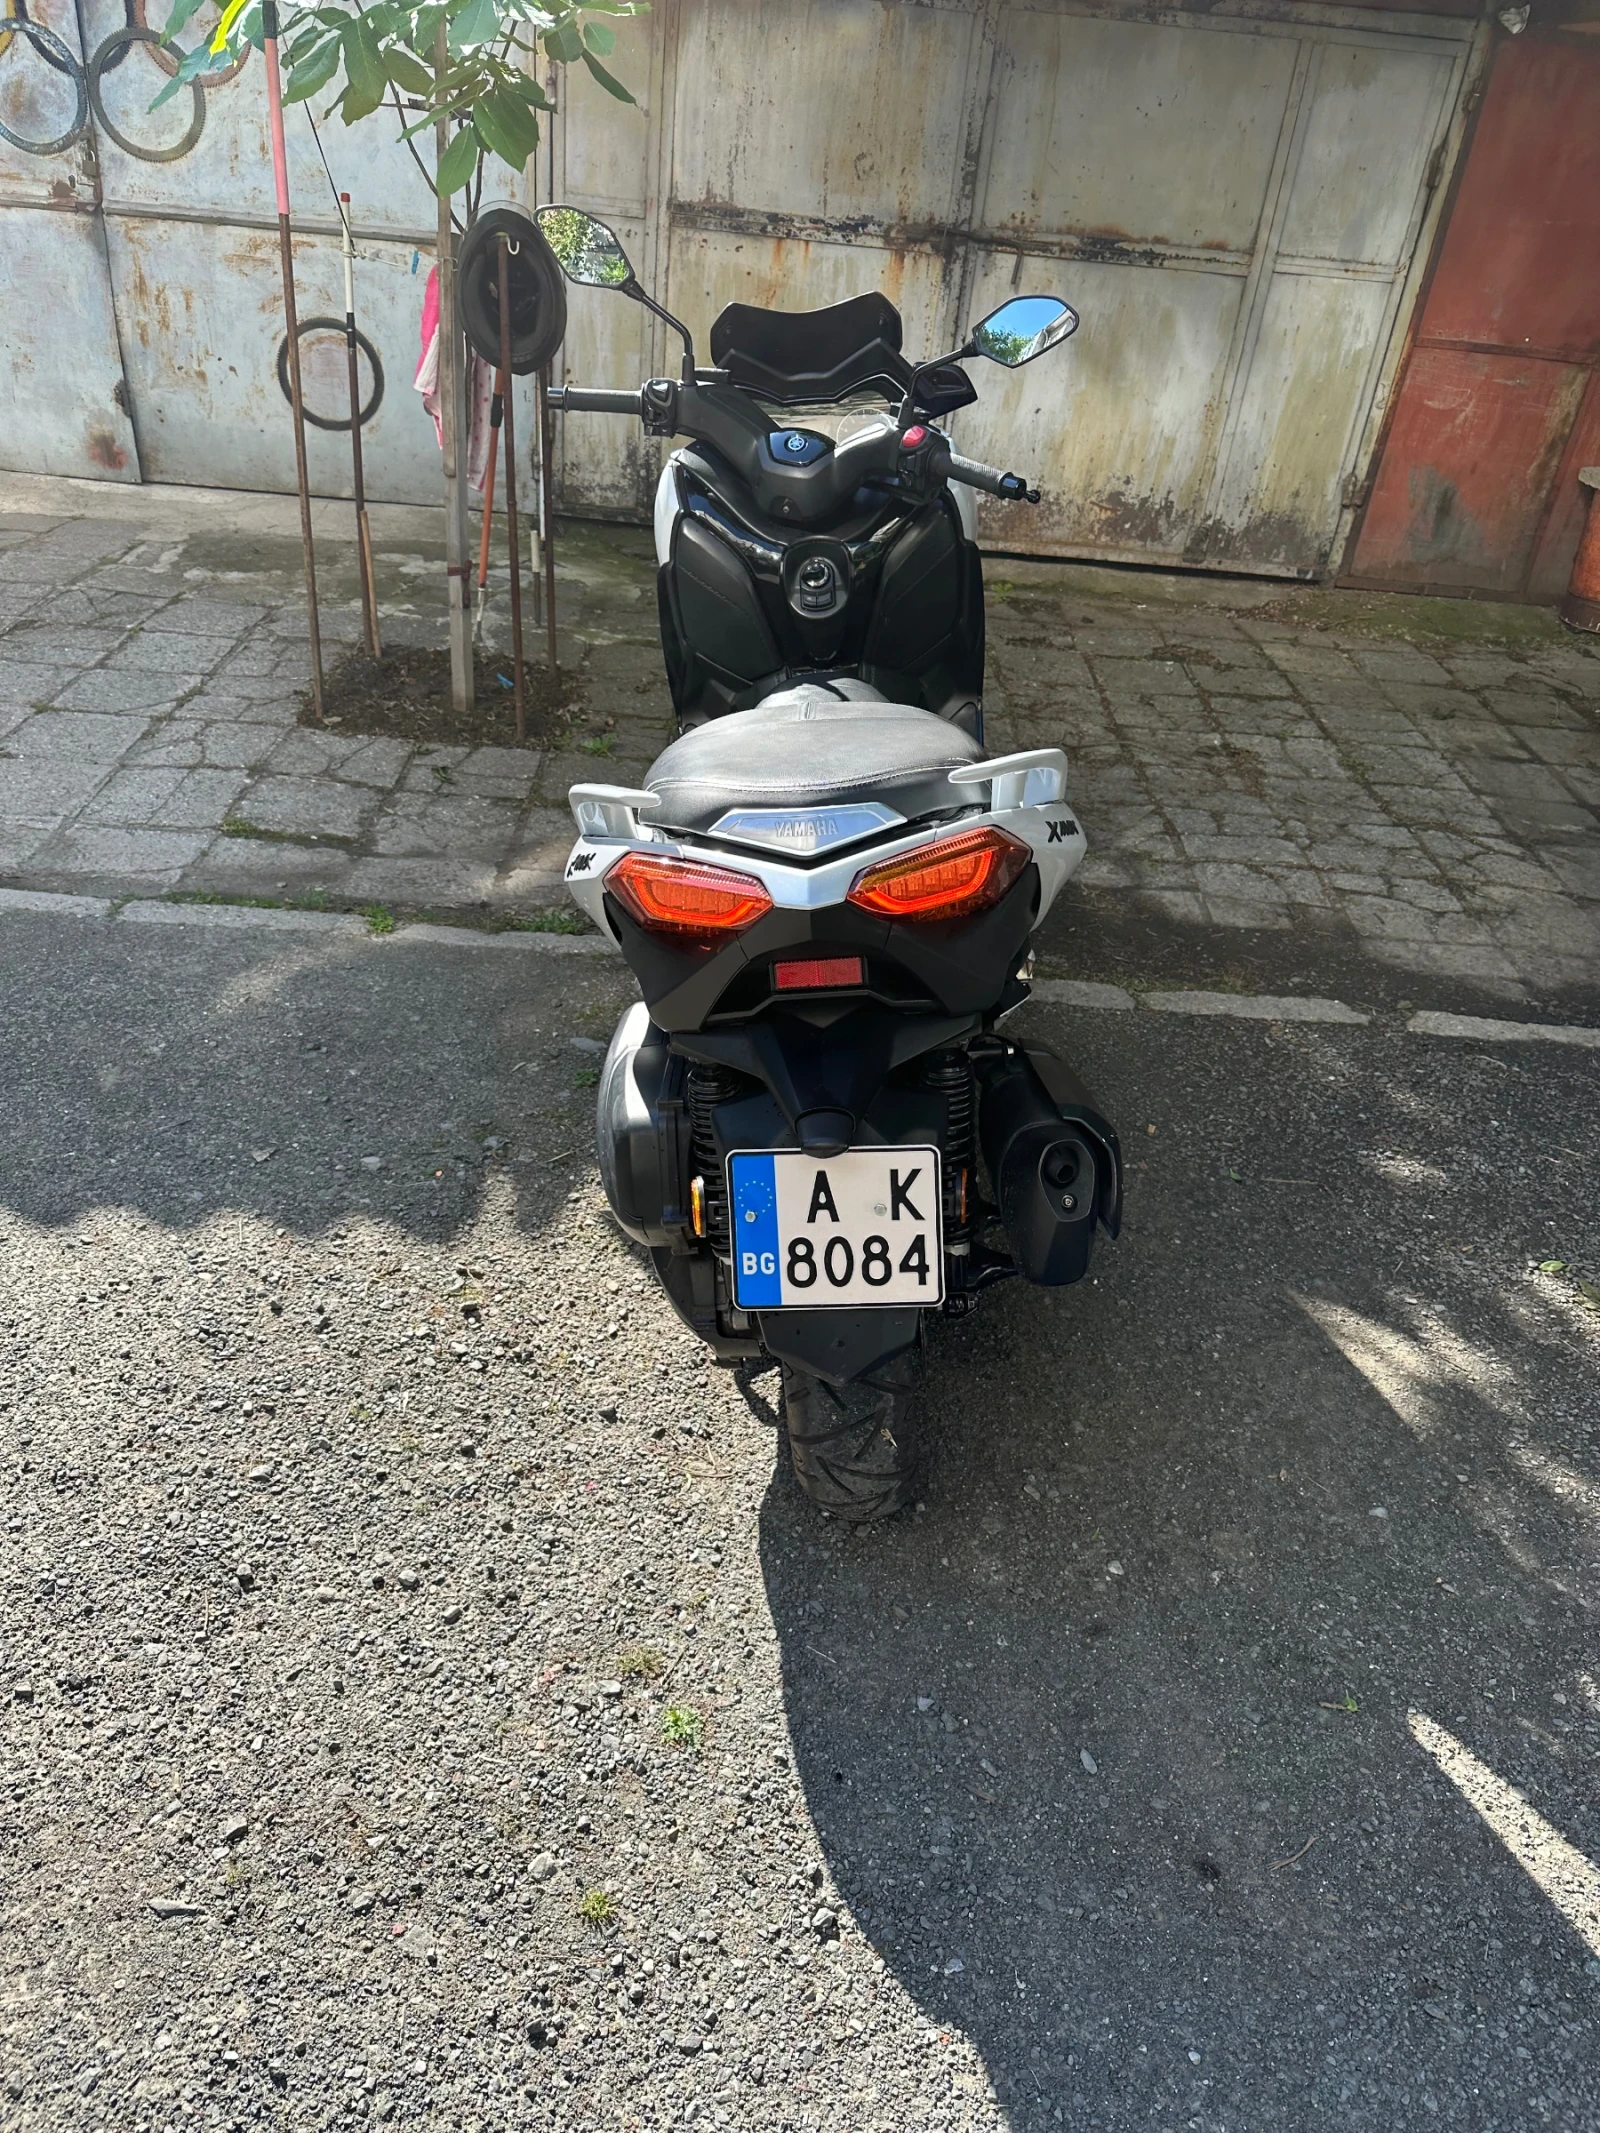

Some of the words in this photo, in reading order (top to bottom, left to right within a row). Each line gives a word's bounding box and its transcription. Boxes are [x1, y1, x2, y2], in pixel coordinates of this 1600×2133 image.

[775, 817, 838, 838] YAMAHA
[806, 1170, 840, 1224] A
[889, 1168, 926, 1221] K
[742, 1252, 776, 1275] BG
[786, 1234, 930, 1289] 8084
